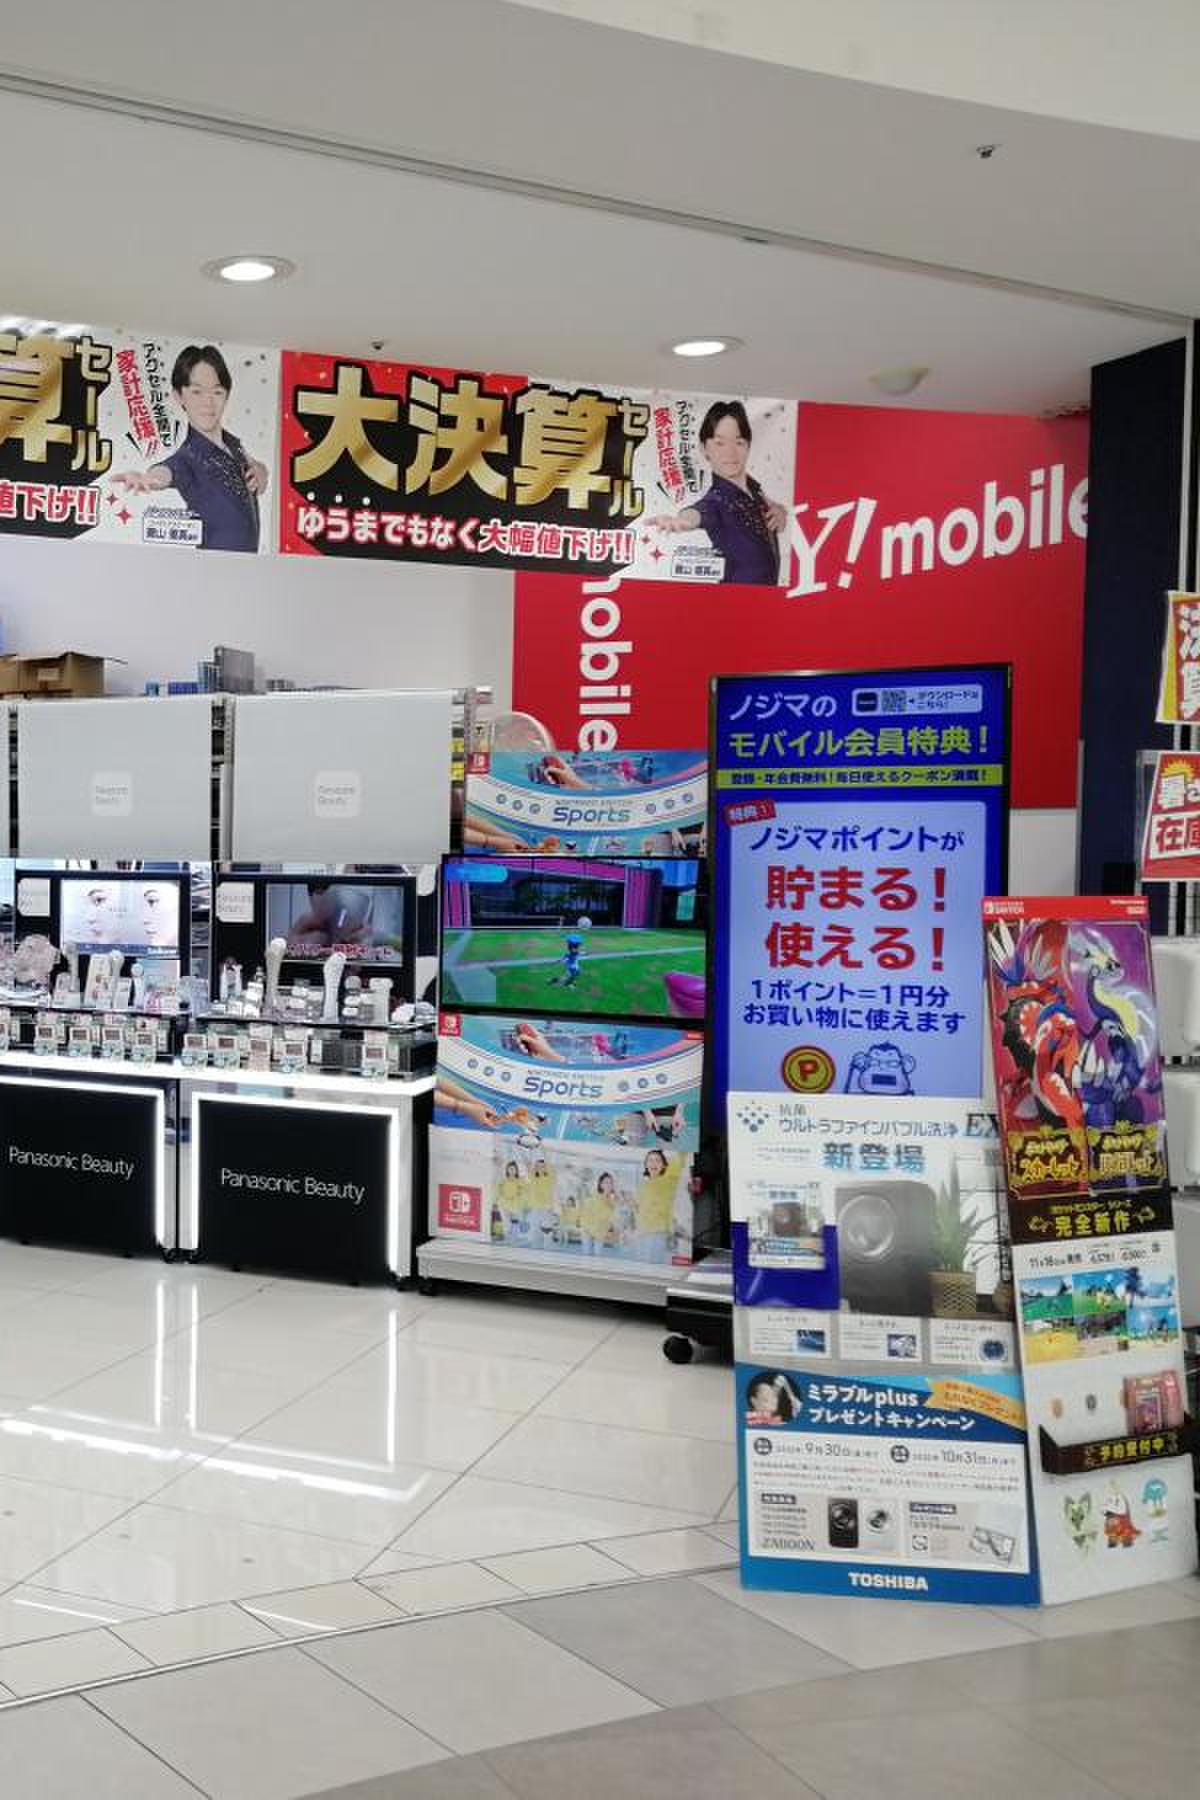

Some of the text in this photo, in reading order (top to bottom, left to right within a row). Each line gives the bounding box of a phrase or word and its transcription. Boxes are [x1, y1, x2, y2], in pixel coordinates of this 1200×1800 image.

[71, 337, 112, 473] セール
[293, 366, 619, 511] 大決算
[609, 398, 649, 518] セール
[578, 574, 633, 751] obile
[730, 691, 838, 721] ノジマの
[729, 725, 988, 758] モバイル会員特典！
[552, 806, 631, 827] Sports
[751, 825, 964, 852] ノジマポイントが
[766, 865, 946, 912] 貯まる！
[765, 922, 945, 971] 使える！
[743, 1003, 966, 1034] お買い物に使えます
[523, 1076, 603, 1098] Sports
[9, 1146, 135, 1181] Panasonic Beauty
[822, 1141, 926, 1173] 新登場
[220, 1168, 366, 1205] Panasonic Beauty
[1055, 1210, 1132, 1238] 完全新作
[808, 1383, 920, 1408] ミラブルplus
[808, 1407, 976, 1430] プレゼントキャンペーン
[847, 1571, 929, 1591] TOSHIBA
